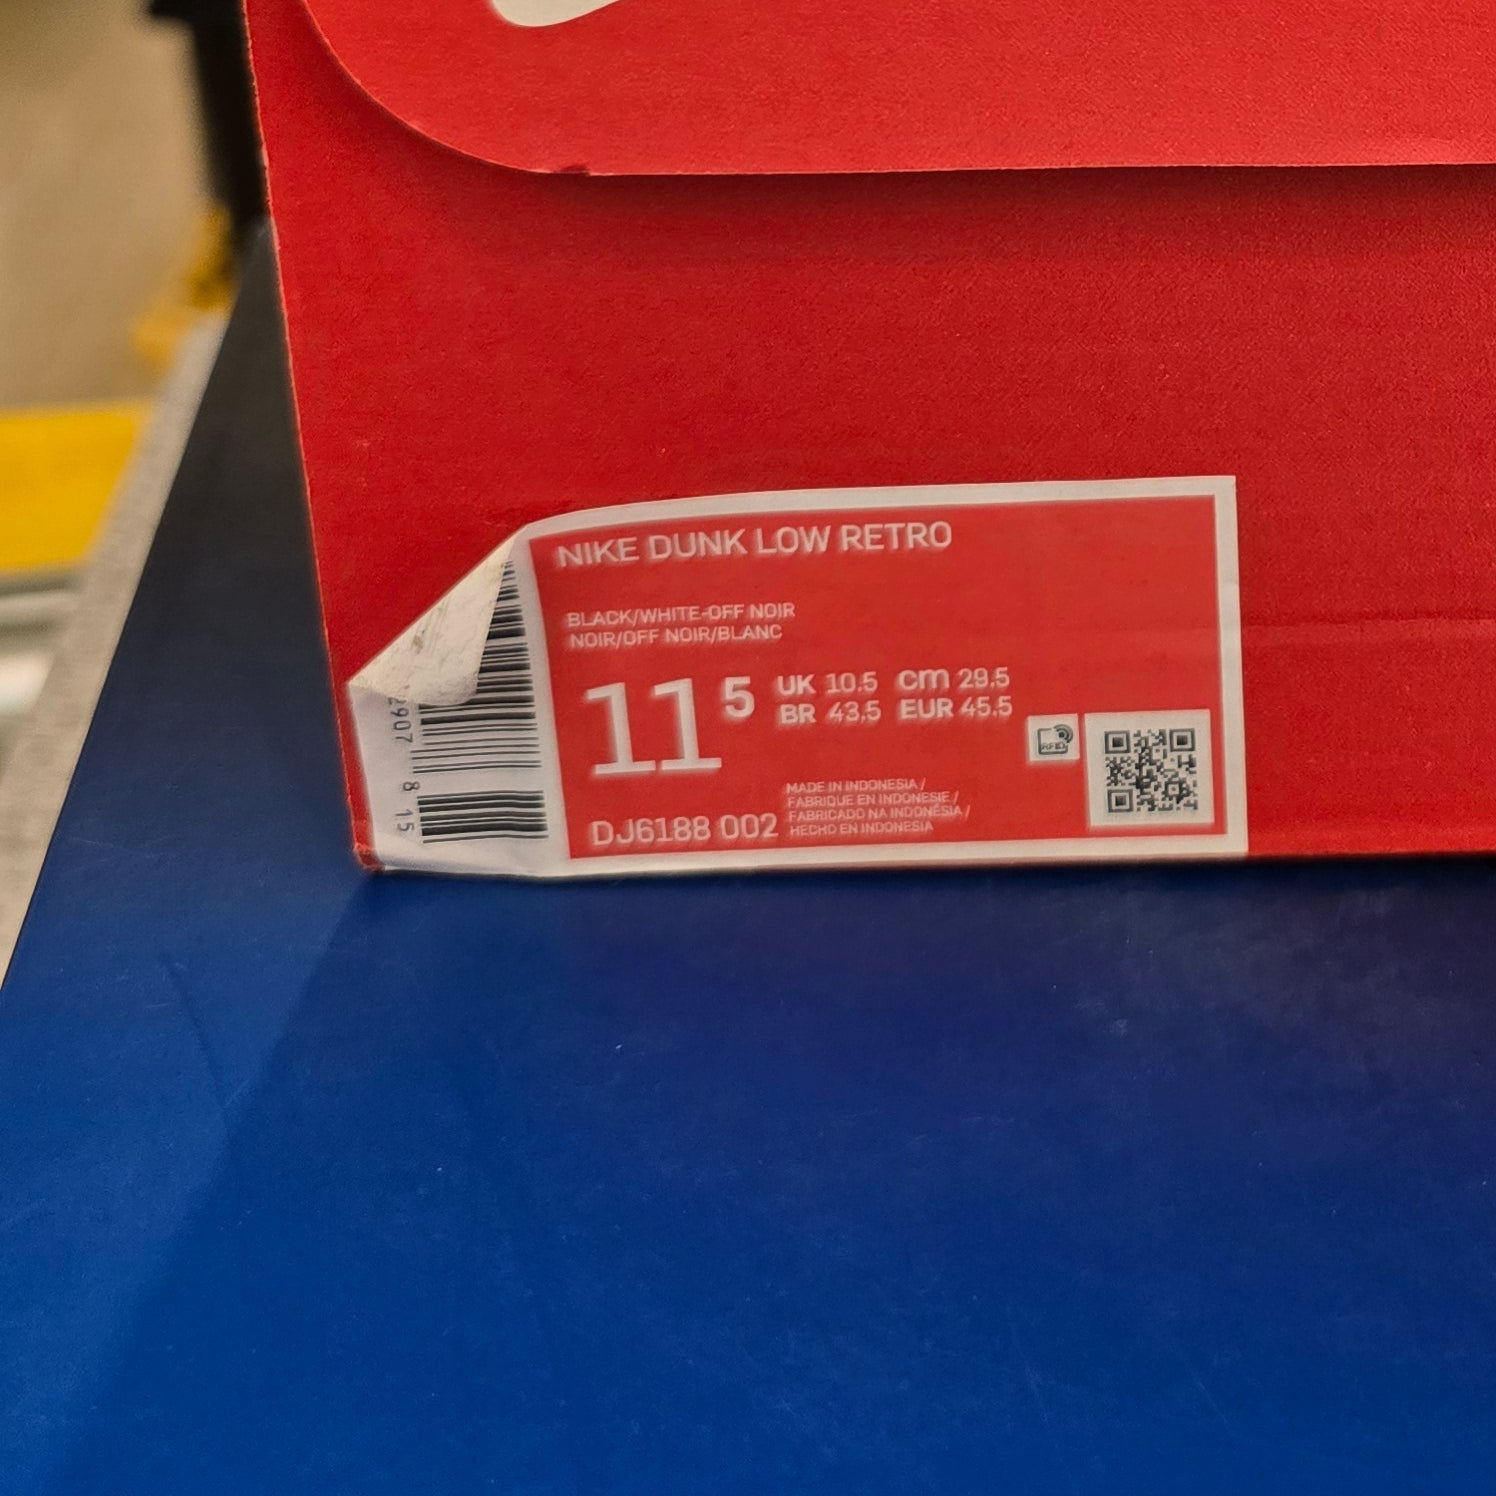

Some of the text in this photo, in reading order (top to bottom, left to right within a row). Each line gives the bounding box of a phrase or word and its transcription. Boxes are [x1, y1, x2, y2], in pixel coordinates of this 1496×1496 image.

[556, 521, 952, 568] NIKE DUNK LOW RETRO
[566, 602, 796, 628] BLACK/WHITE-OFF NOIR
[570, 623, 783, 649] NOIR/OFF NOIR/BLANC
[777, 667, 1010, 696] UK 10.5 cm 29.5
[779, 703, 816, 724] BR
[900, 697, 954, 720] EUR
[960, 695, 1012, 717] 45.5
[585, 676, 756, 775] 11 5
[402, 781, 420, 792] 8
[785, 781, 825, 794] MADE
[829, 780, 842, 792] IN
[845, 778, 918, 792] INDONESIA
[787, 794, 854, 808] FABRIQUE
[857, 793, 876, 805] EN
[395, 808, 415, 833] 15
[788, 807, 866, 822] FABRICADO
[868, 807, 888, 819] NA
[591, 812, 779, 847] DJ6188 002
[789, 820, 935, 836] HECHO EN INDONESIA
